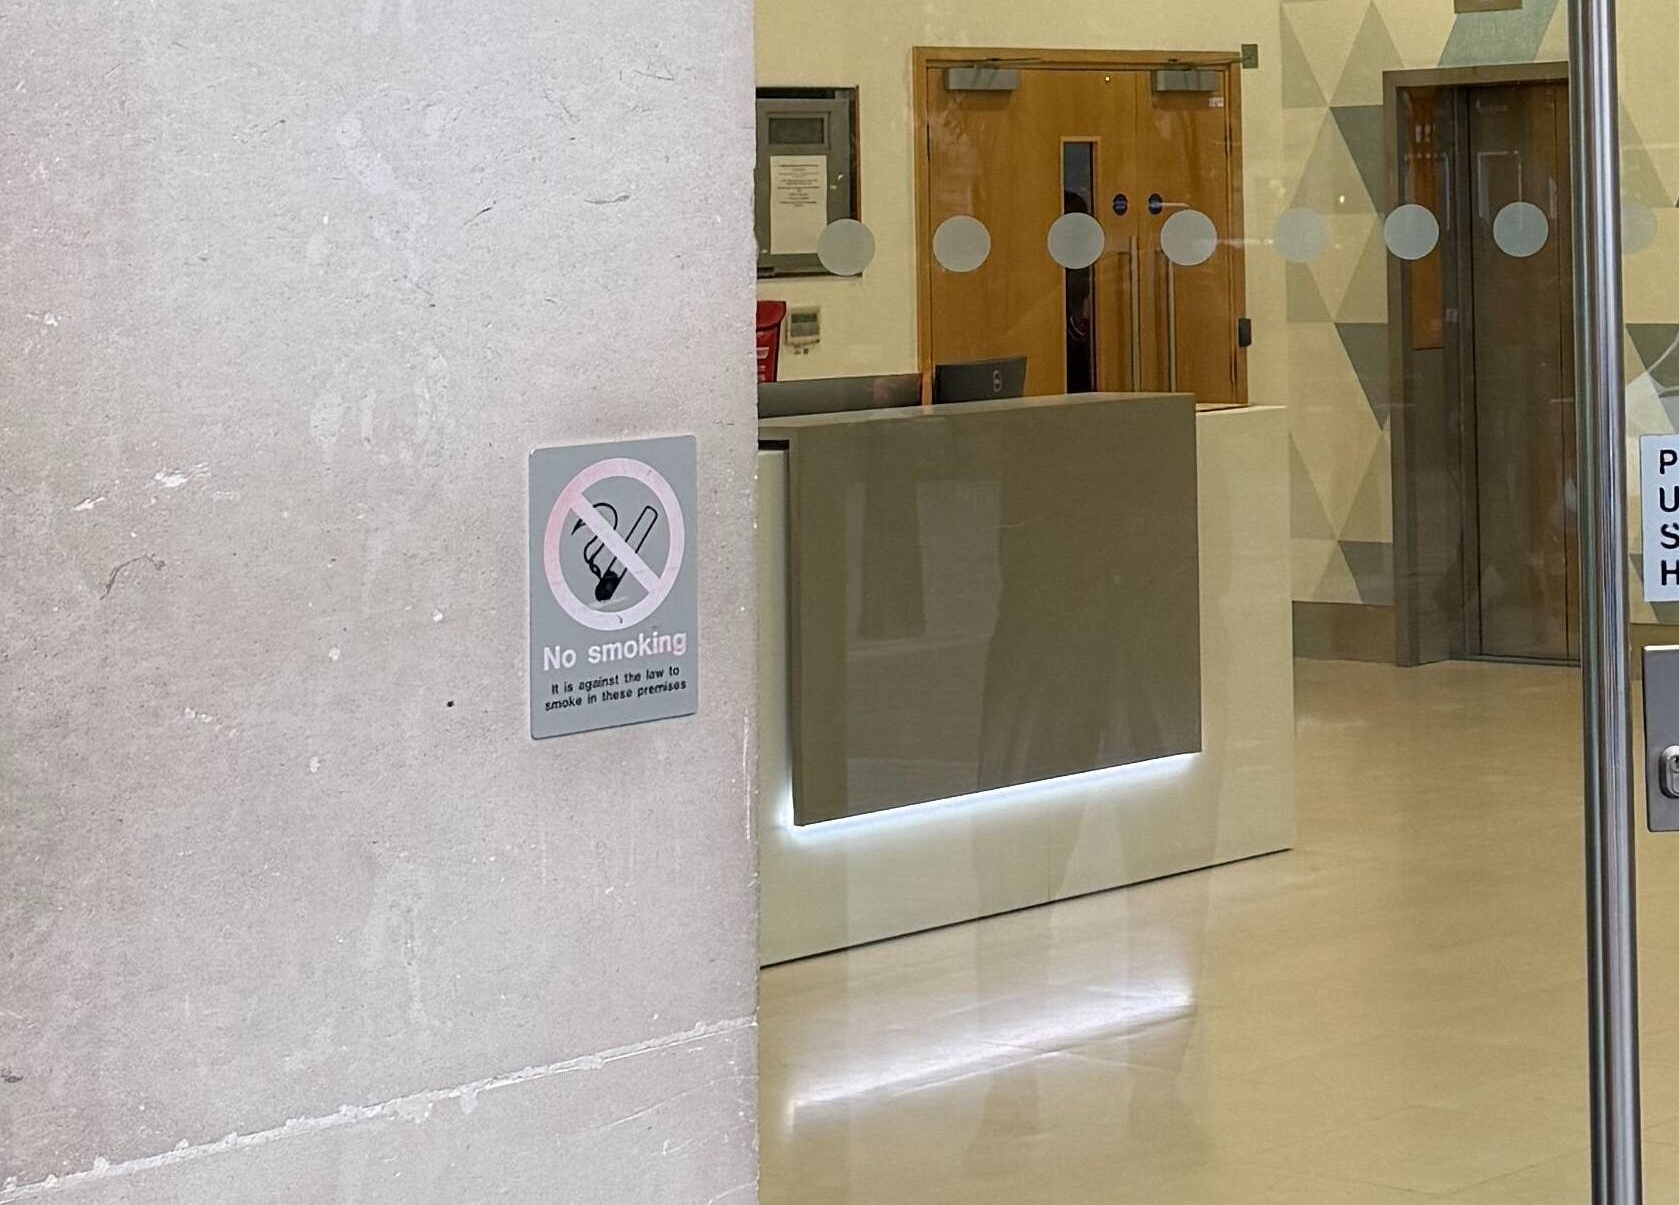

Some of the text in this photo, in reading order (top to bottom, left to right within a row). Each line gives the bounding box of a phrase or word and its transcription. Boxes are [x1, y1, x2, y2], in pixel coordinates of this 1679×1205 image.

[543, 631, 687, 671] No smoking
[545, 679, 687, 712] smoke in these premises
[551, 666, 680, 695] It is against the law to
